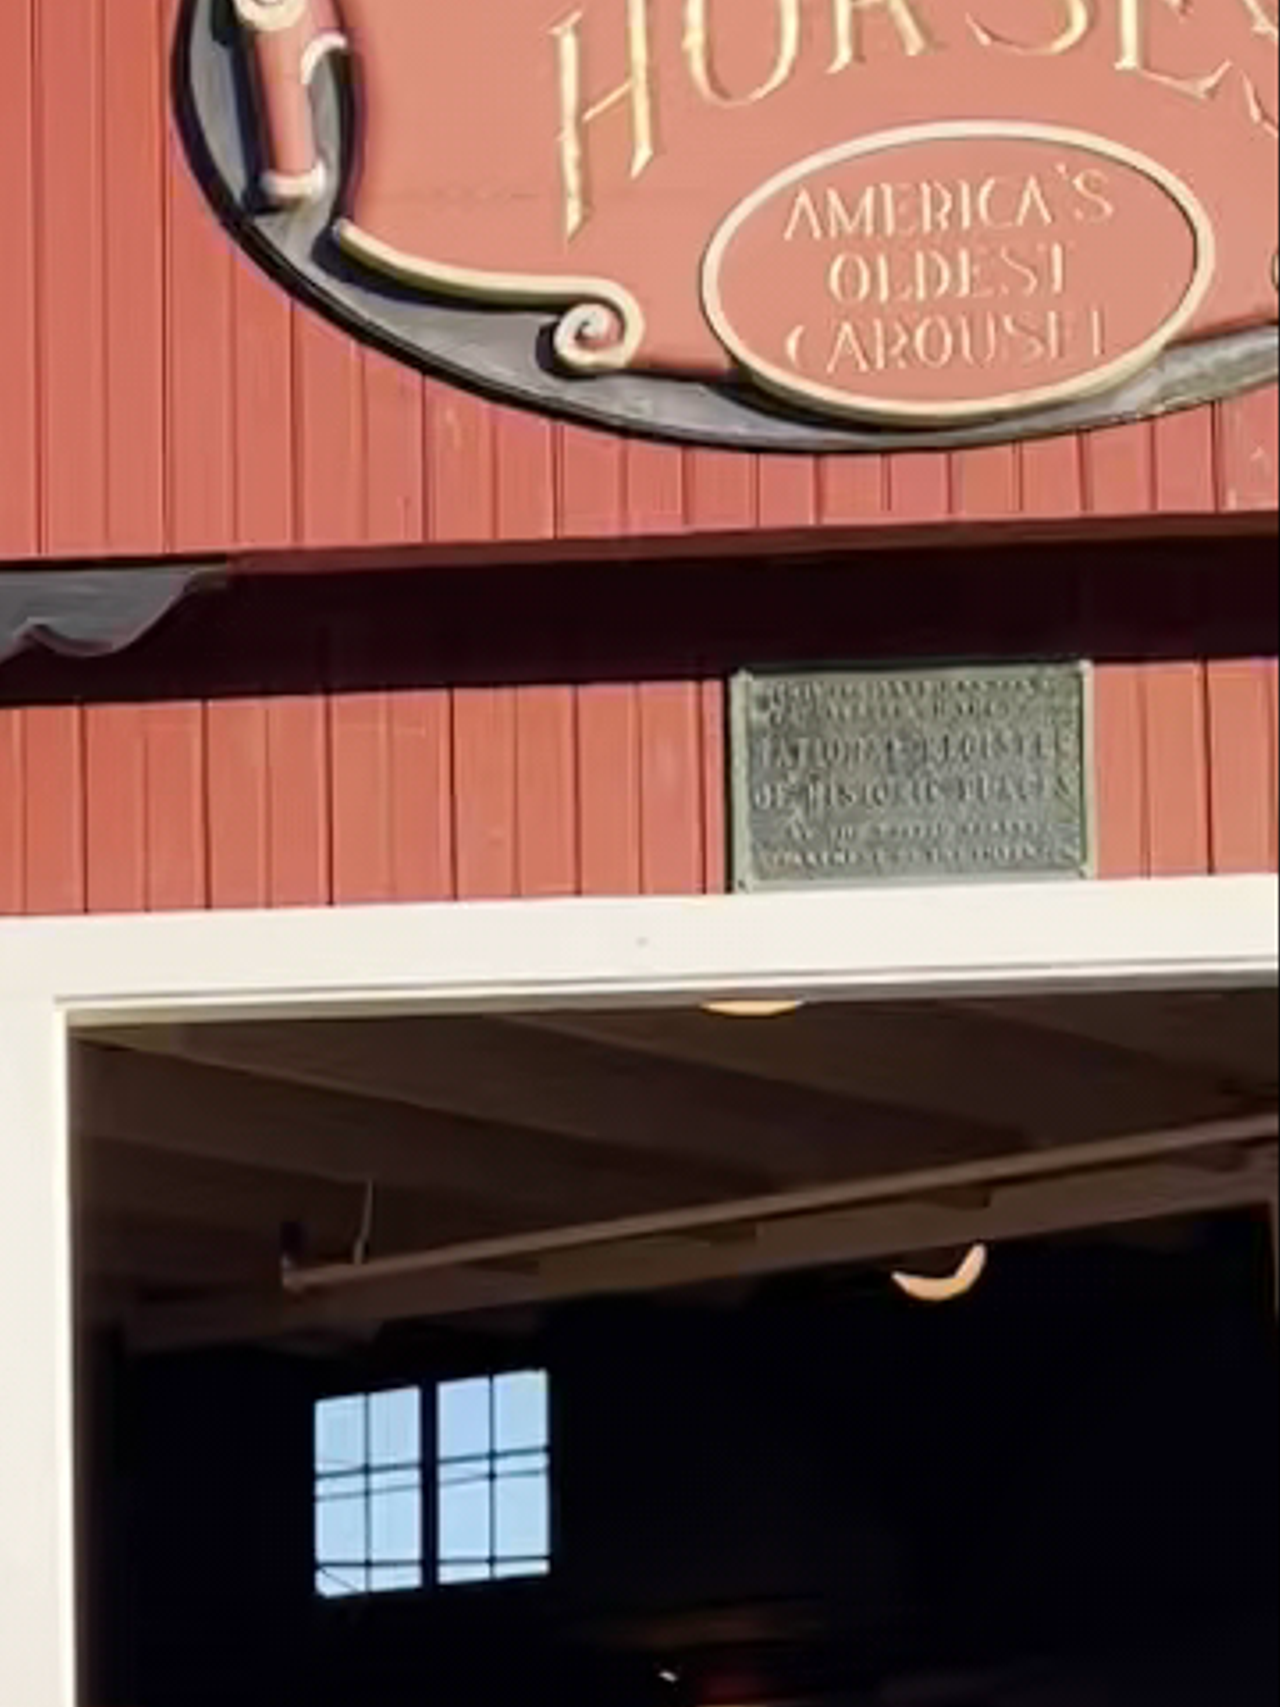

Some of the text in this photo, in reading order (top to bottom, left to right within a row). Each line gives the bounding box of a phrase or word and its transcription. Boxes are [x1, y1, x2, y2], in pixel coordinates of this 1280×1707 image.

[783, 162, 1115, 241] AMERICA'S
[826, 242, 1076, 305] OLDEST
[784, 305, 1108, 375] CAROUSEL
